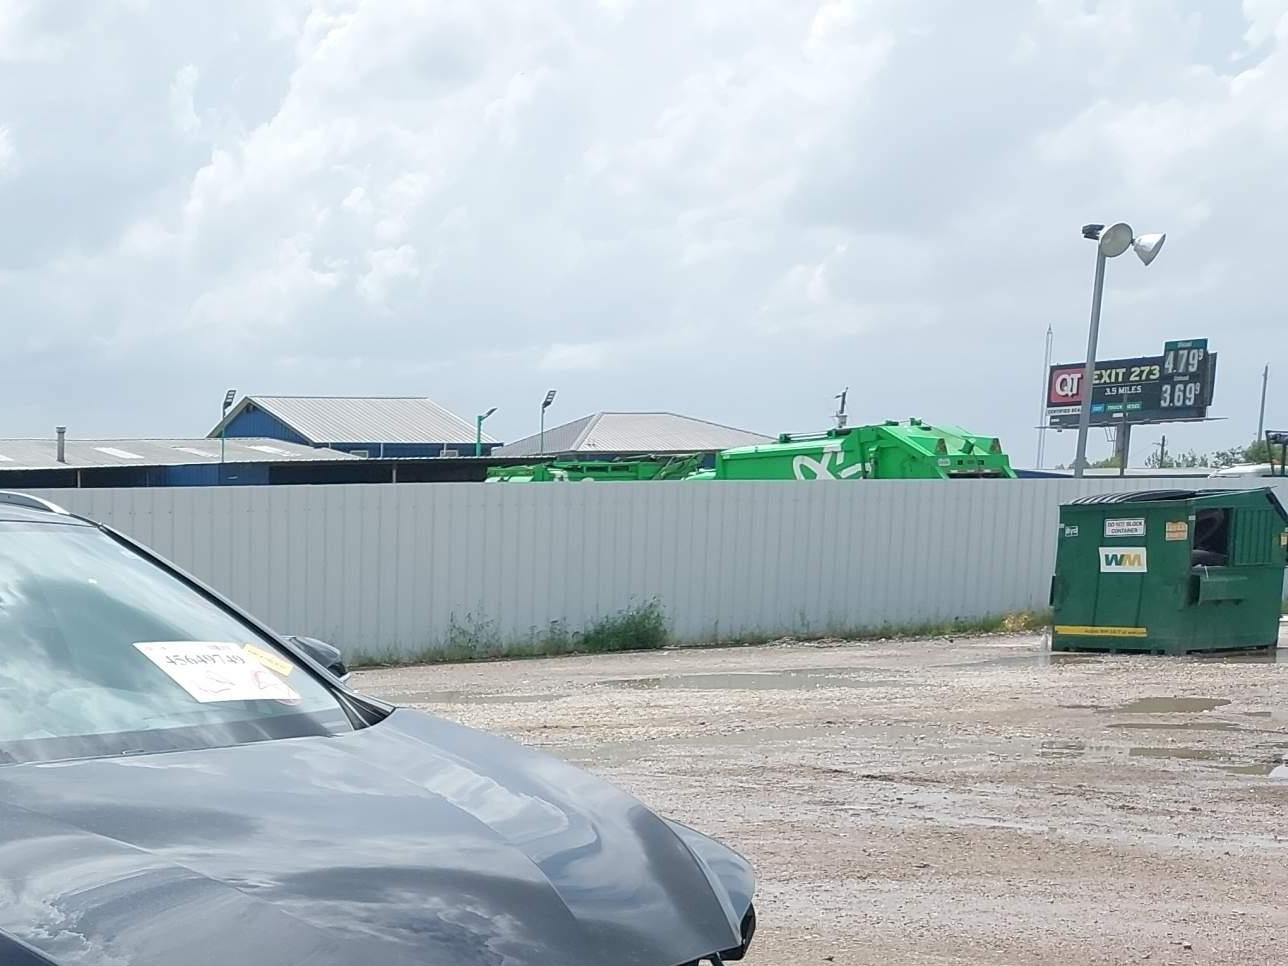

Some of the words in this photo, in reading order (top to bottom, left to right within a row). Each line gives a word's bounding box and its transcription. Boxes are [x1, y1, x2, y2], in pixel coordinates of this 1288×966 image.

[1093, 368, 1126, 384] EXIT
[1129, 365, 1160, 381] 273
[1055, 373, 1082, 397] QT
[1118, 385, 1142, 394] MILES
[1104, 553, 1143, 566] WM
[166, 653, 246, 666] 45649749
